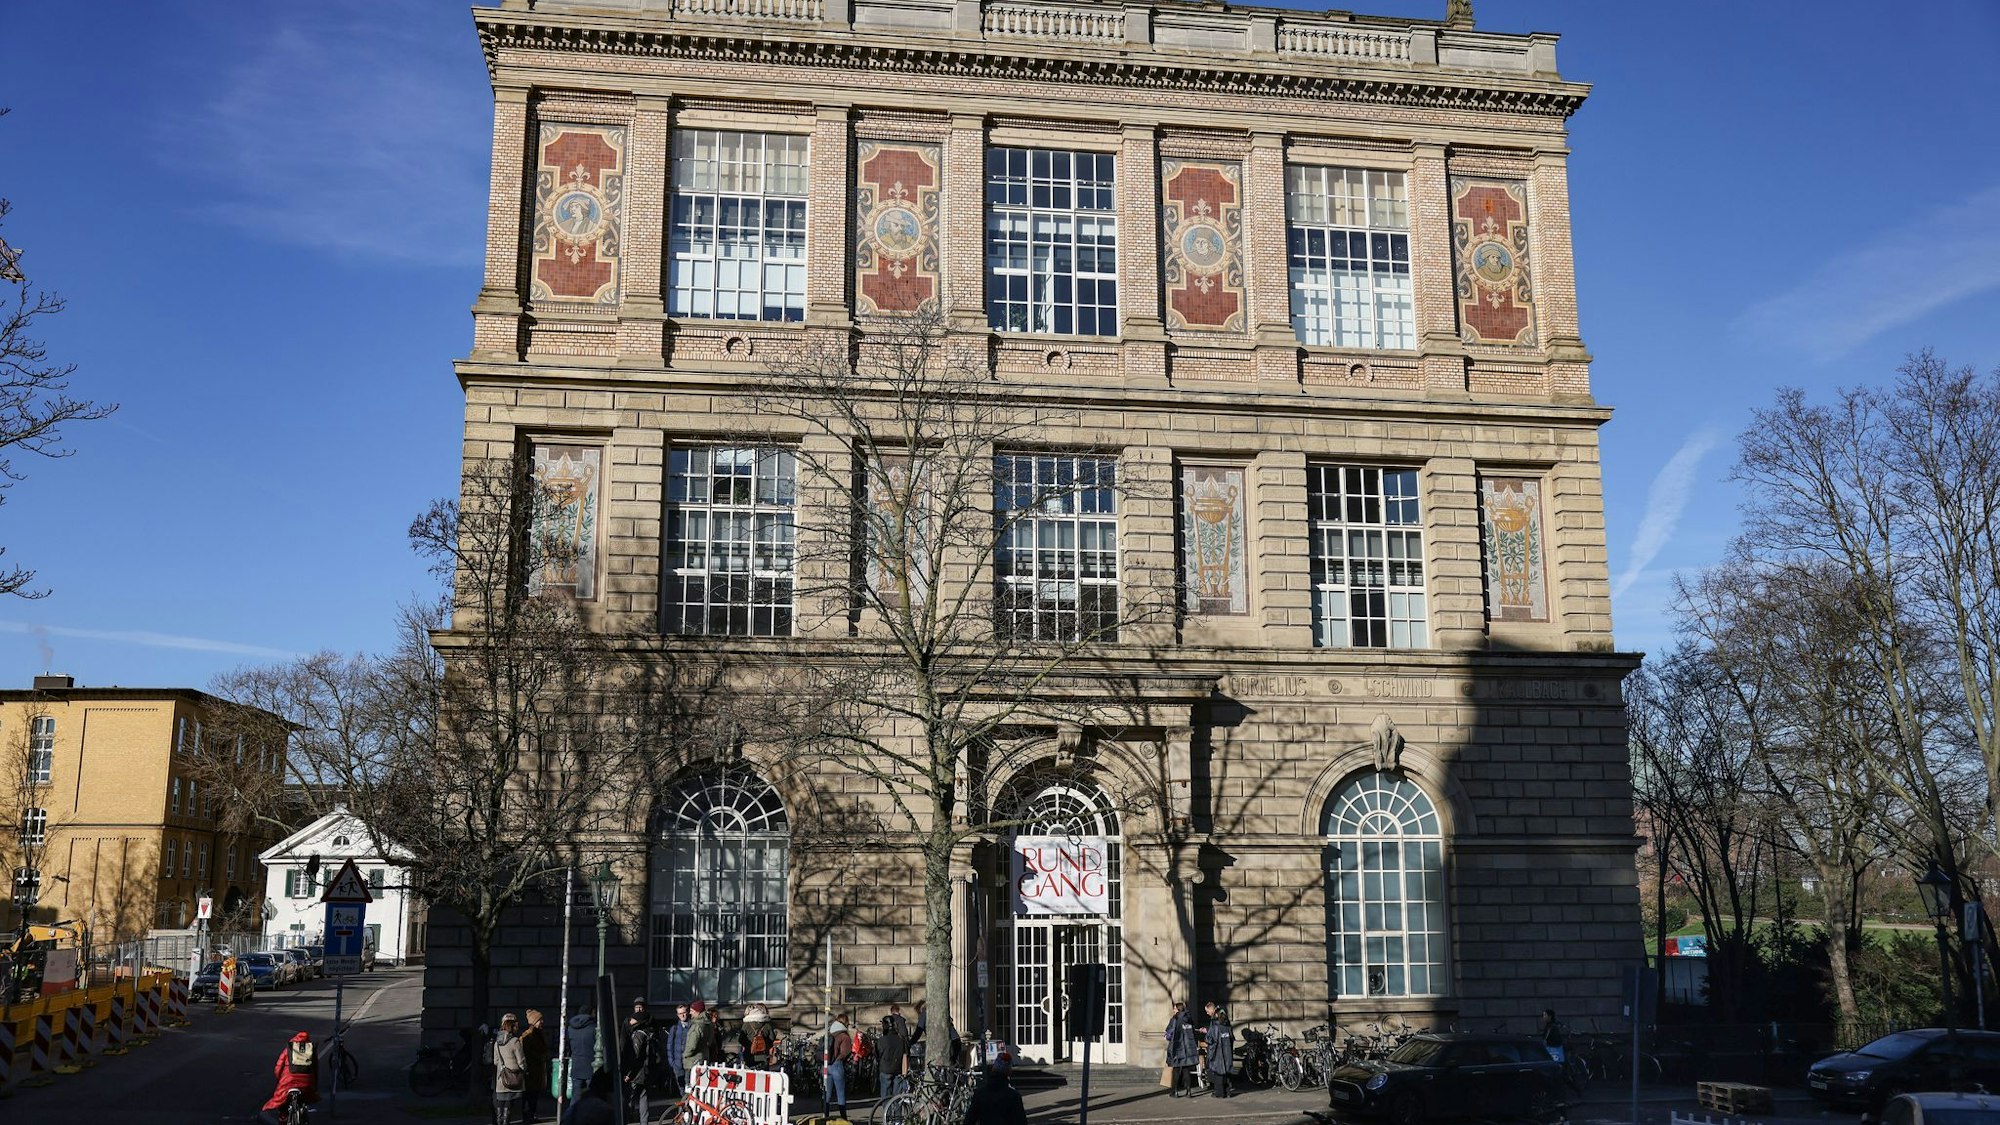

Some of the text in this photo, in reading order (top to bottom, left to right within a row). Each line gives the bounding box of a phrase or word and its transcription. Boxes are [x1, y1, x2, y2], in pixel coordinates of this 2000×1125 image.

[1229, 676, 1307, 697] CORNELIUS
[1372, 678, 1433, 698] SCHWIND
[1022, 847, 1102, 873] RUND
[1017, 871, 1104, 898] GANG
[1153, 936, 1159, 946] 1
